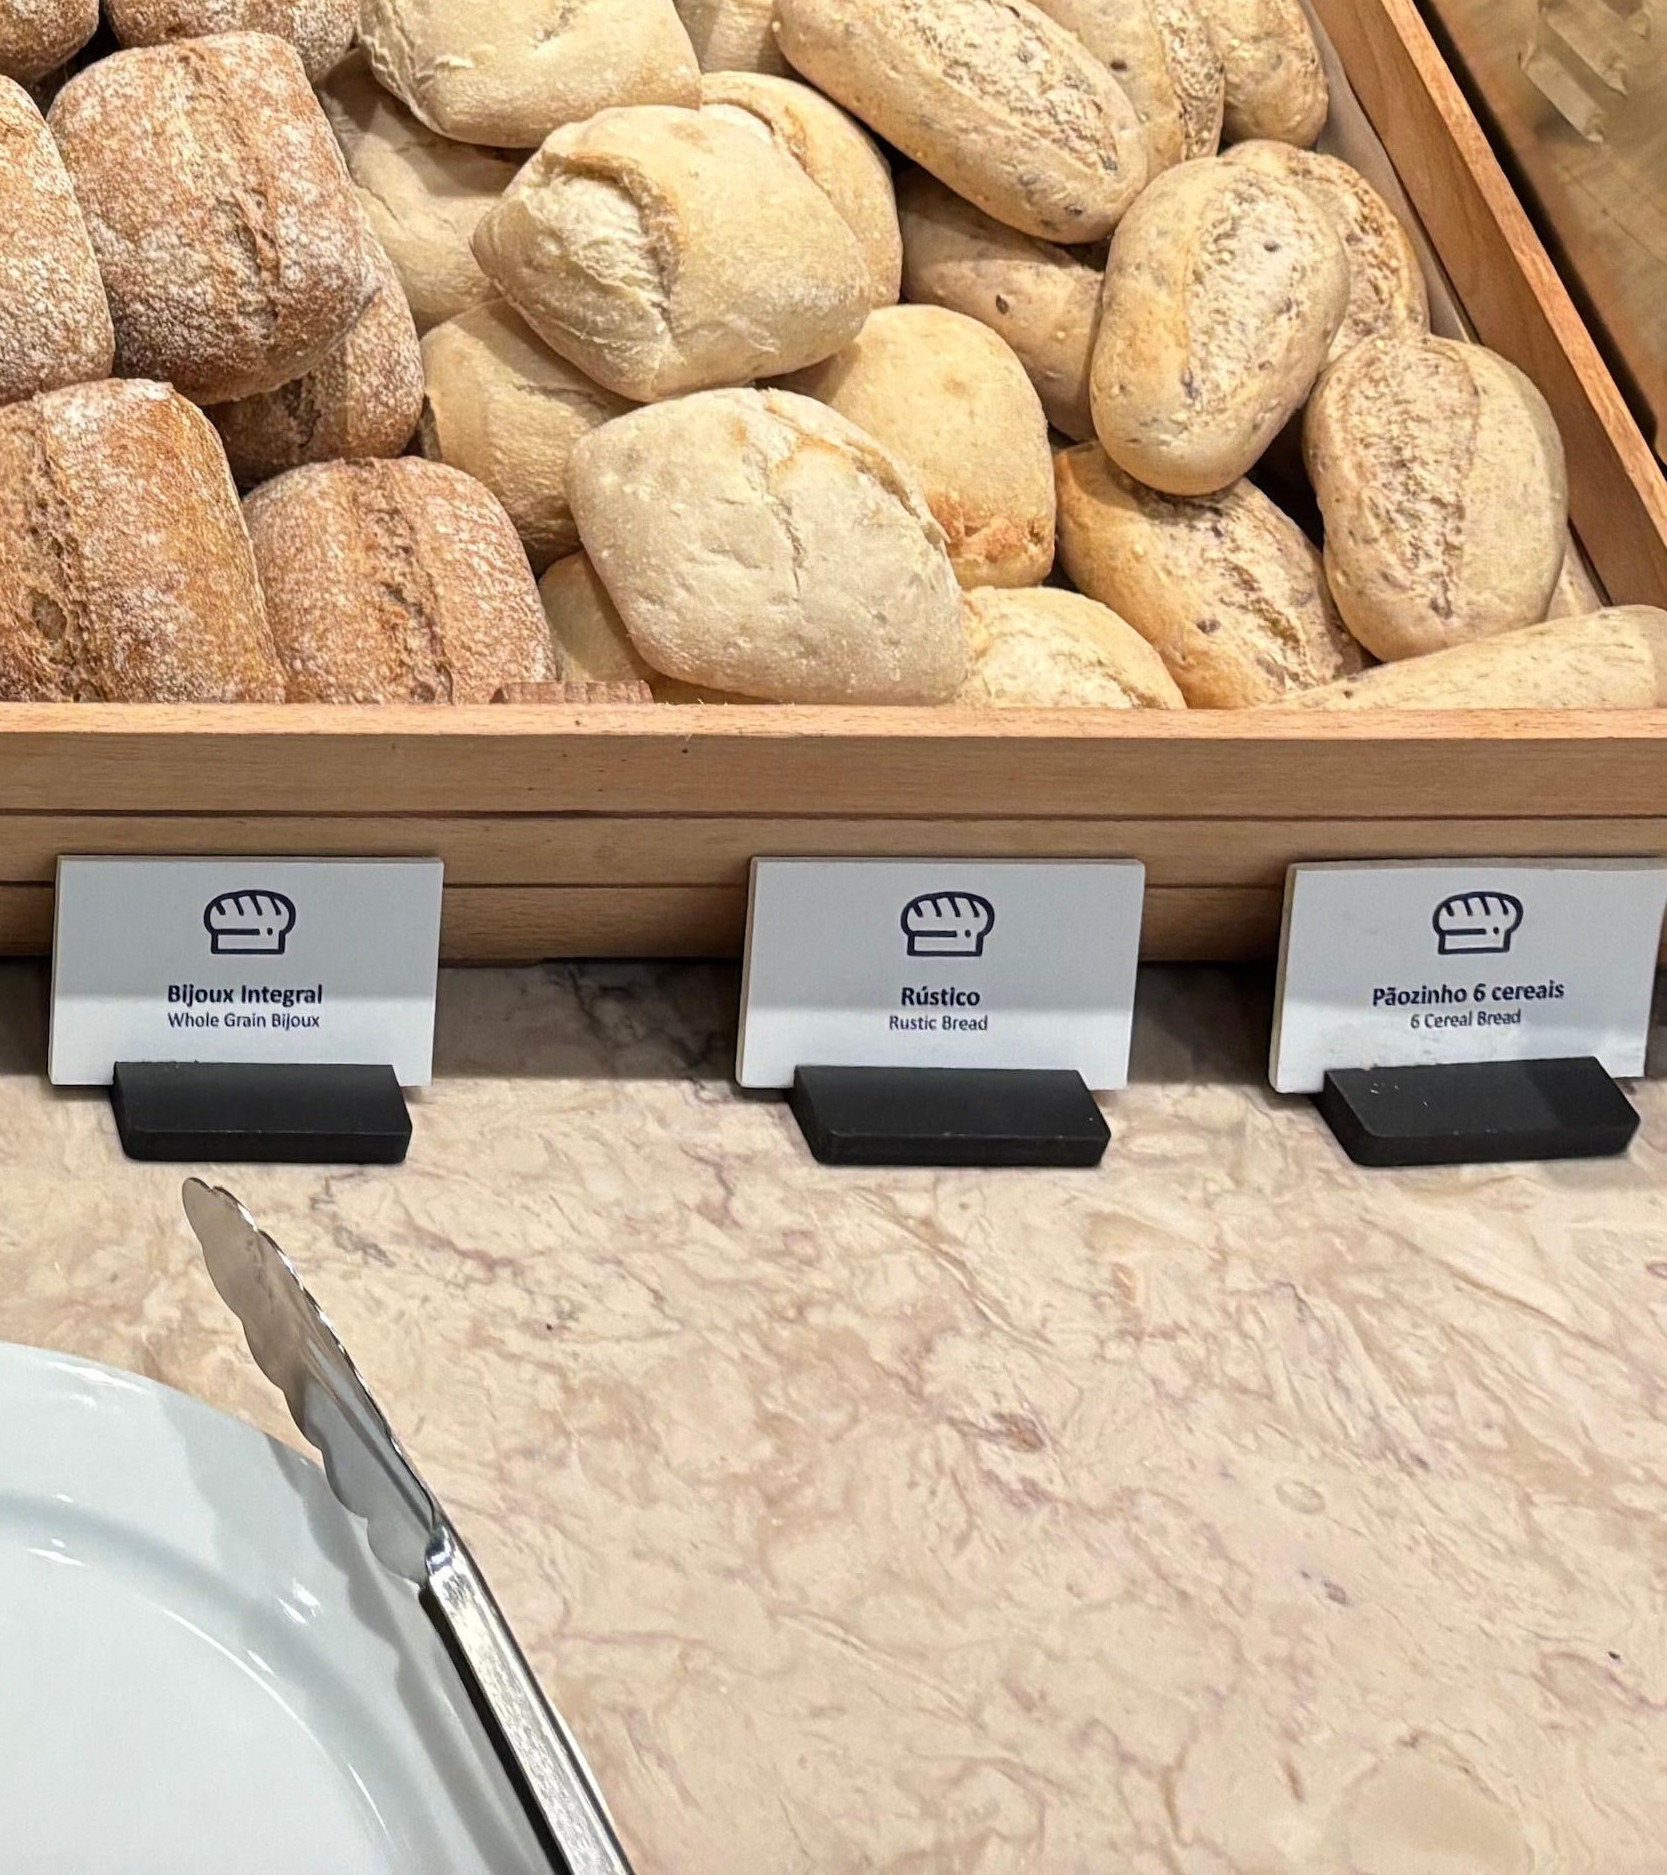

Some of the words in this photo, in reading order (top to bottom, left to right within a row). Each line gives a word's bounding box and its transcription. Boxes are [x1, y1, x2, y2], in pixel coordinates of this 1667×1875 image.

[167, 983, 235, 1009] Bijoux
[240, 983, 323, 1009] Integral
[900, 984, 981, 1008] Rústico
[1372, 983, 1469, 1008] Pãozinho
[1472, 982, 1487, 1003] 6
[1490, 978, 1565, 1002] cereais
[167, 1010, 220, 1029] Whole
[223, 1011, 267, 1029] Grain
[271, 1011, 320, 1032] Bijoux
[888, 1014, 938, 1032] Rustic
[941, 1014, 989, 1032] Bread
[1409, 1013, 1421, 1030] 6
[1423, 1008, 1474, 1030] Cereal
[1476, 1007, 1522, 1028] Bread
